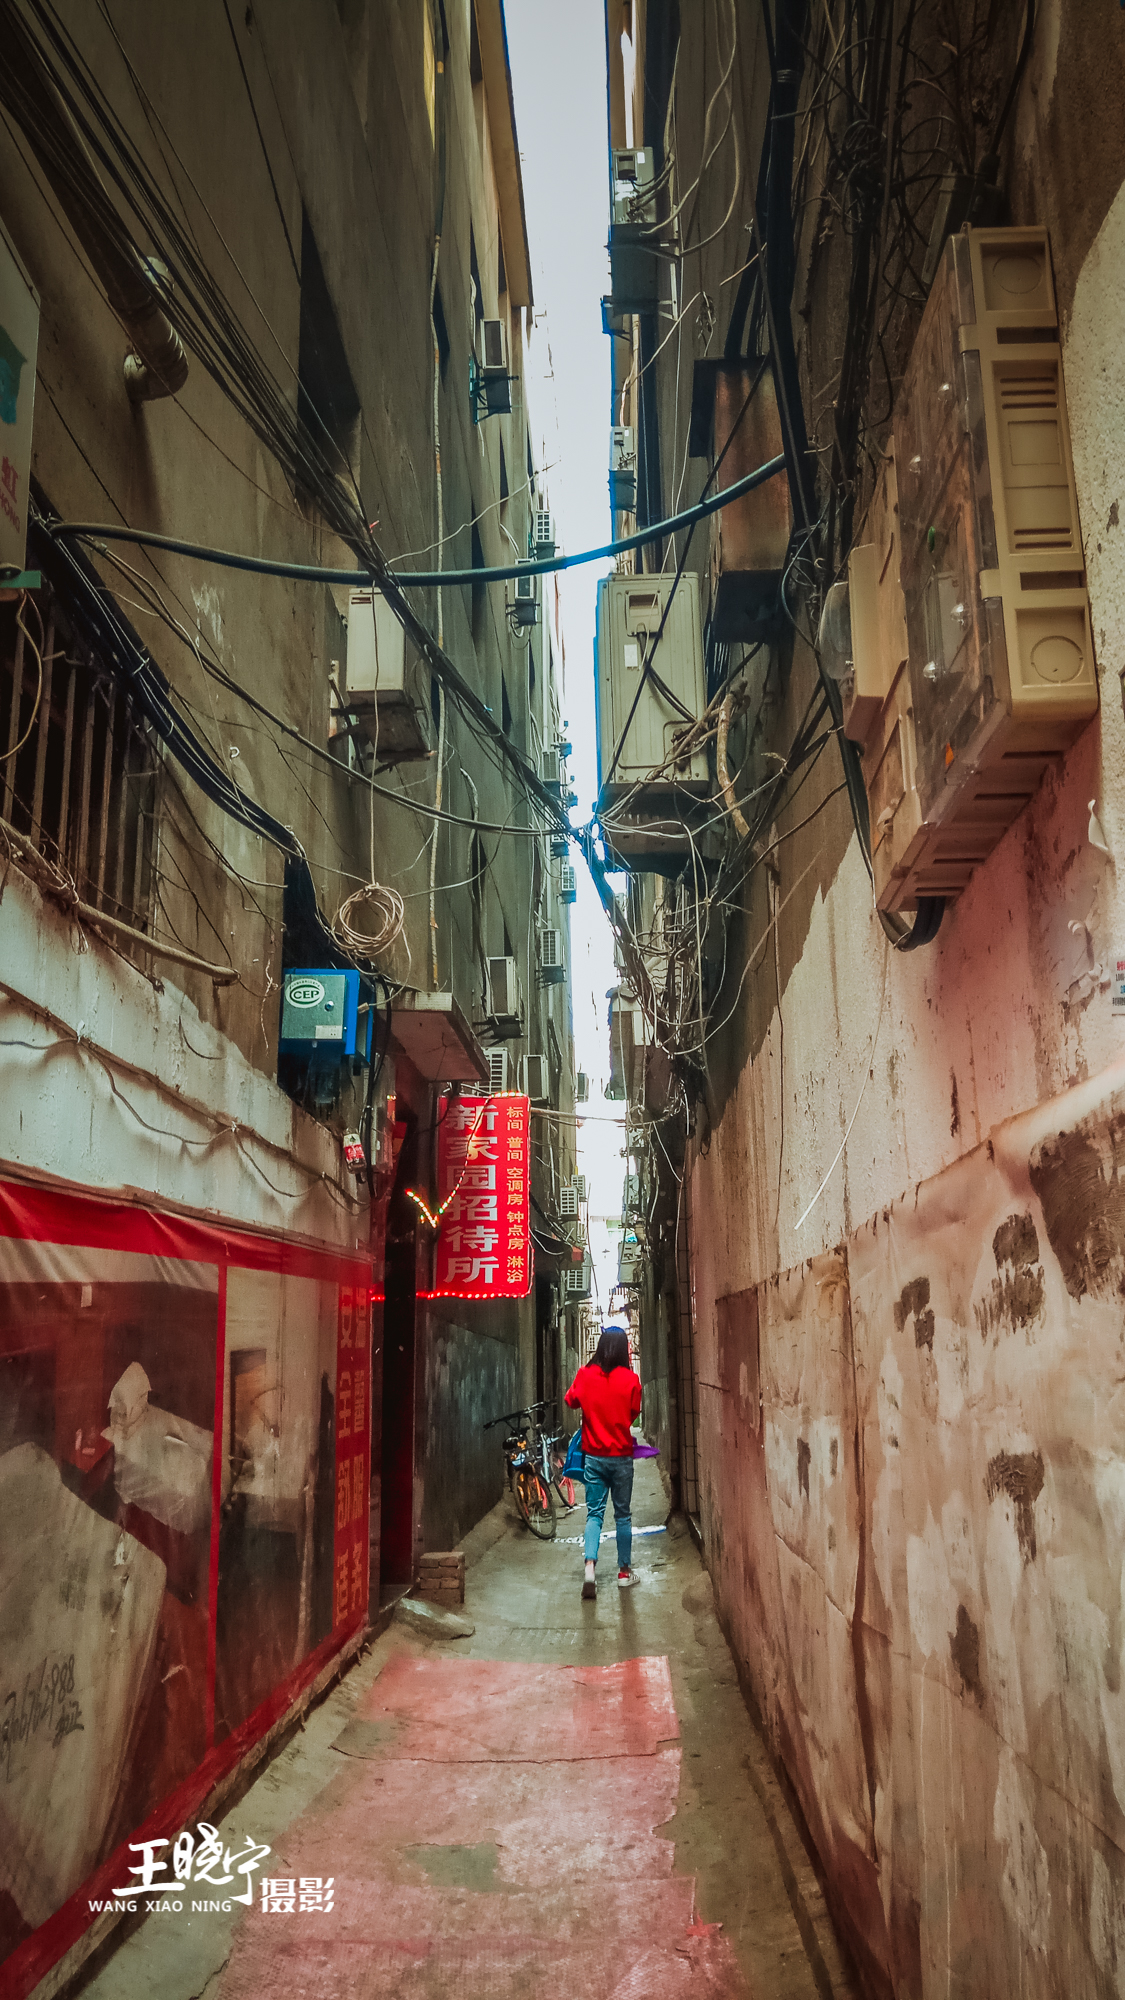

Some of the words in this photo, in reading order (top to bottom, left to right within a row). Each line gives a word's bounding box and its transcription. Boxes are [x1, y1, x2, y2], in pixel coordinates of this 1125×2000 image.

[293, 990, 320, 1000] CEP
[506, 1106, 524, 1131] 标间
[506, 1136, 524, 1162] 普间
[443, 1104, 500, 1284] 新家园招待所
[506, 1167, 524, 1206] 空调房
[506, 1211, 525, 1250] 钟点房
[506, 1256, 525, 1283] 淋浴
